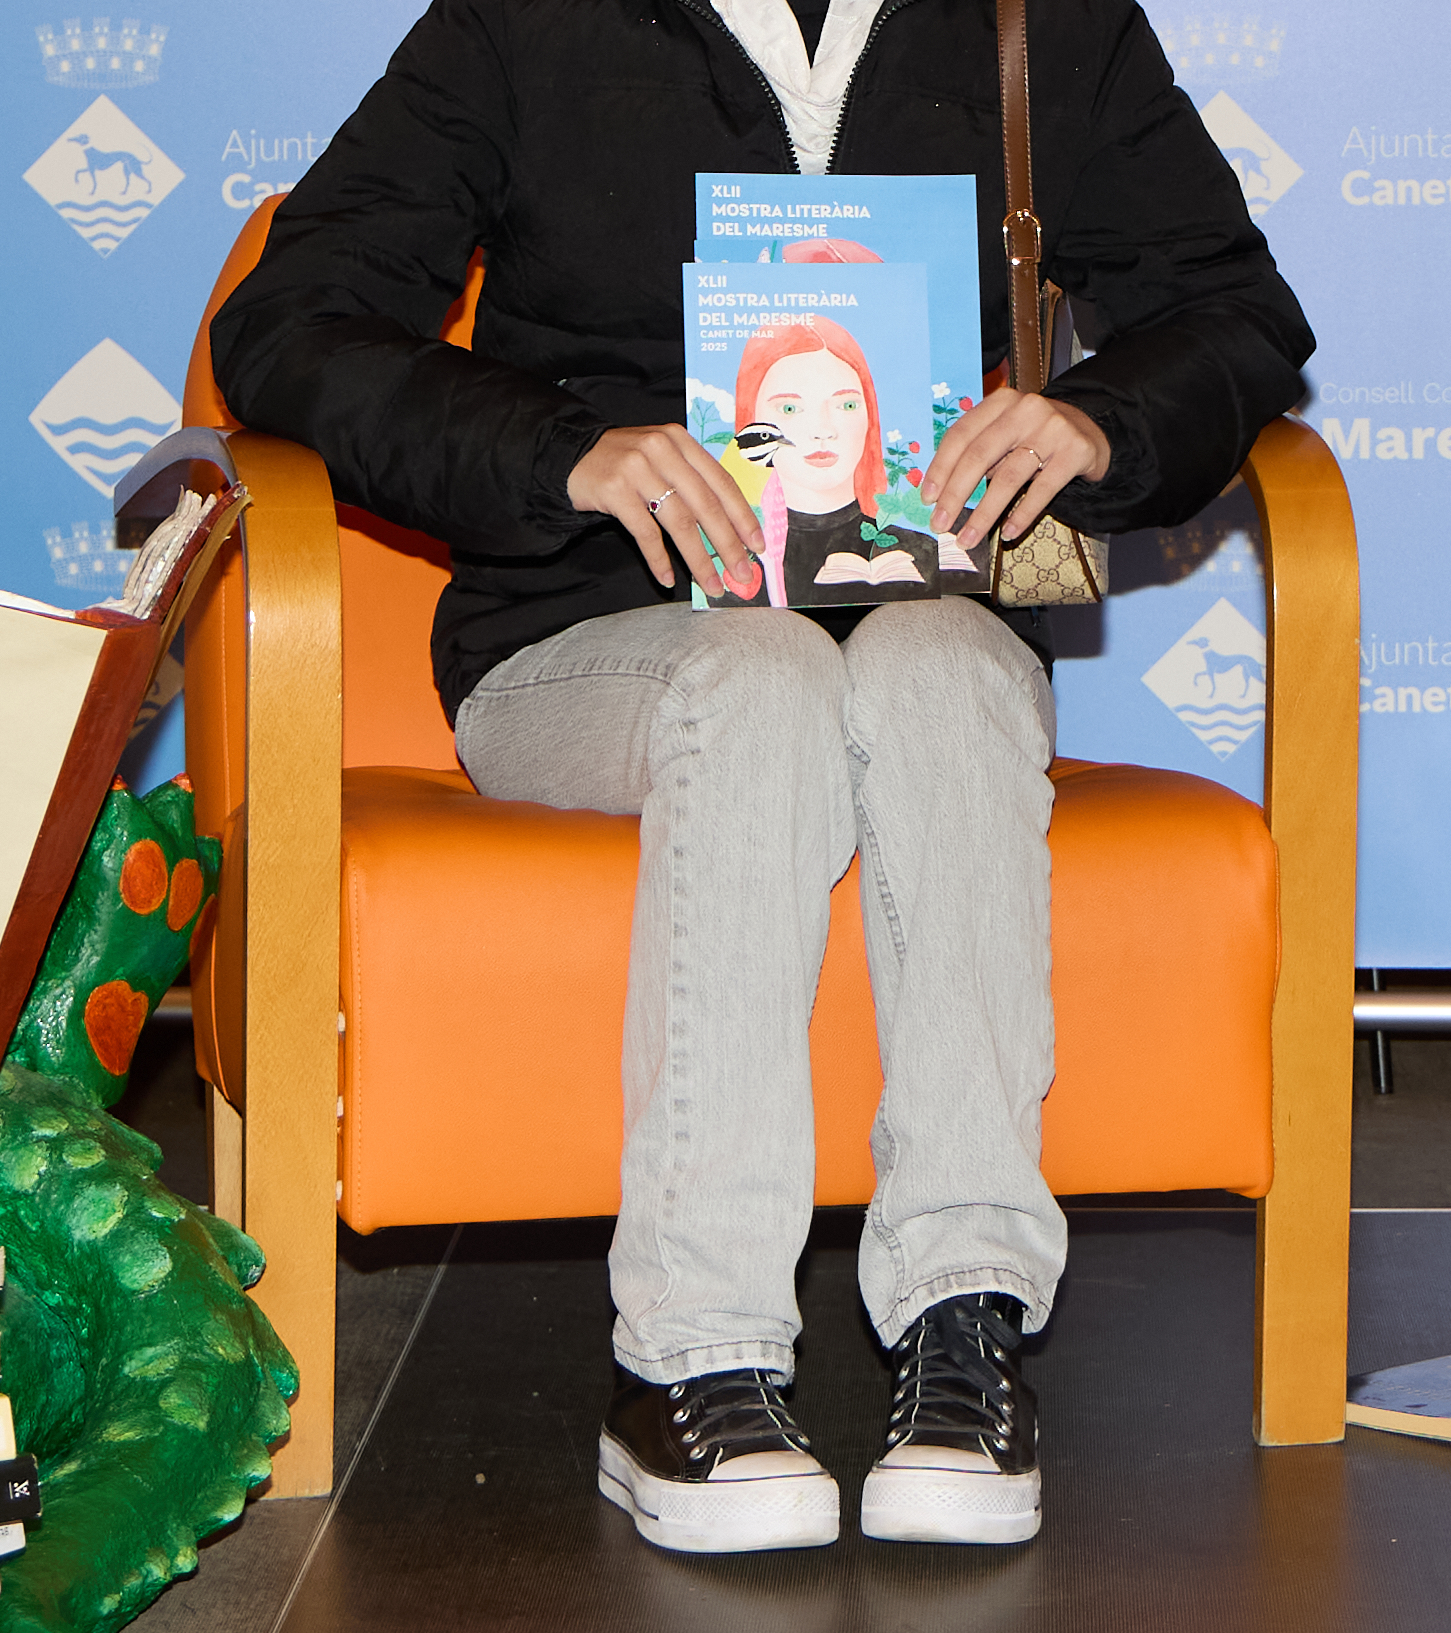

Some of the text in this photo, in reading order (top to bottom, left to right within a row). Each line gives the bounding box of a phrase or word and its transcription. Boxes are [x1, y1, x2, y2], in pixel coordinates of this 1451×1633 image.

[711, 185, 740, 198] XLII
[712, 199, 871, 219] MOSTRA LITERÀRIA
[712, 222, 828, 237] DEL MARESME
[698, 275, 727, 288] XLII
[698, 289, 859, 308] MOSTRA LITERÀRIA
[698, 312, 815, 327] DEL MARESME
[700, 329, 775, 339] CANET DE MAR
[700, 341, 728, 352] 2025
